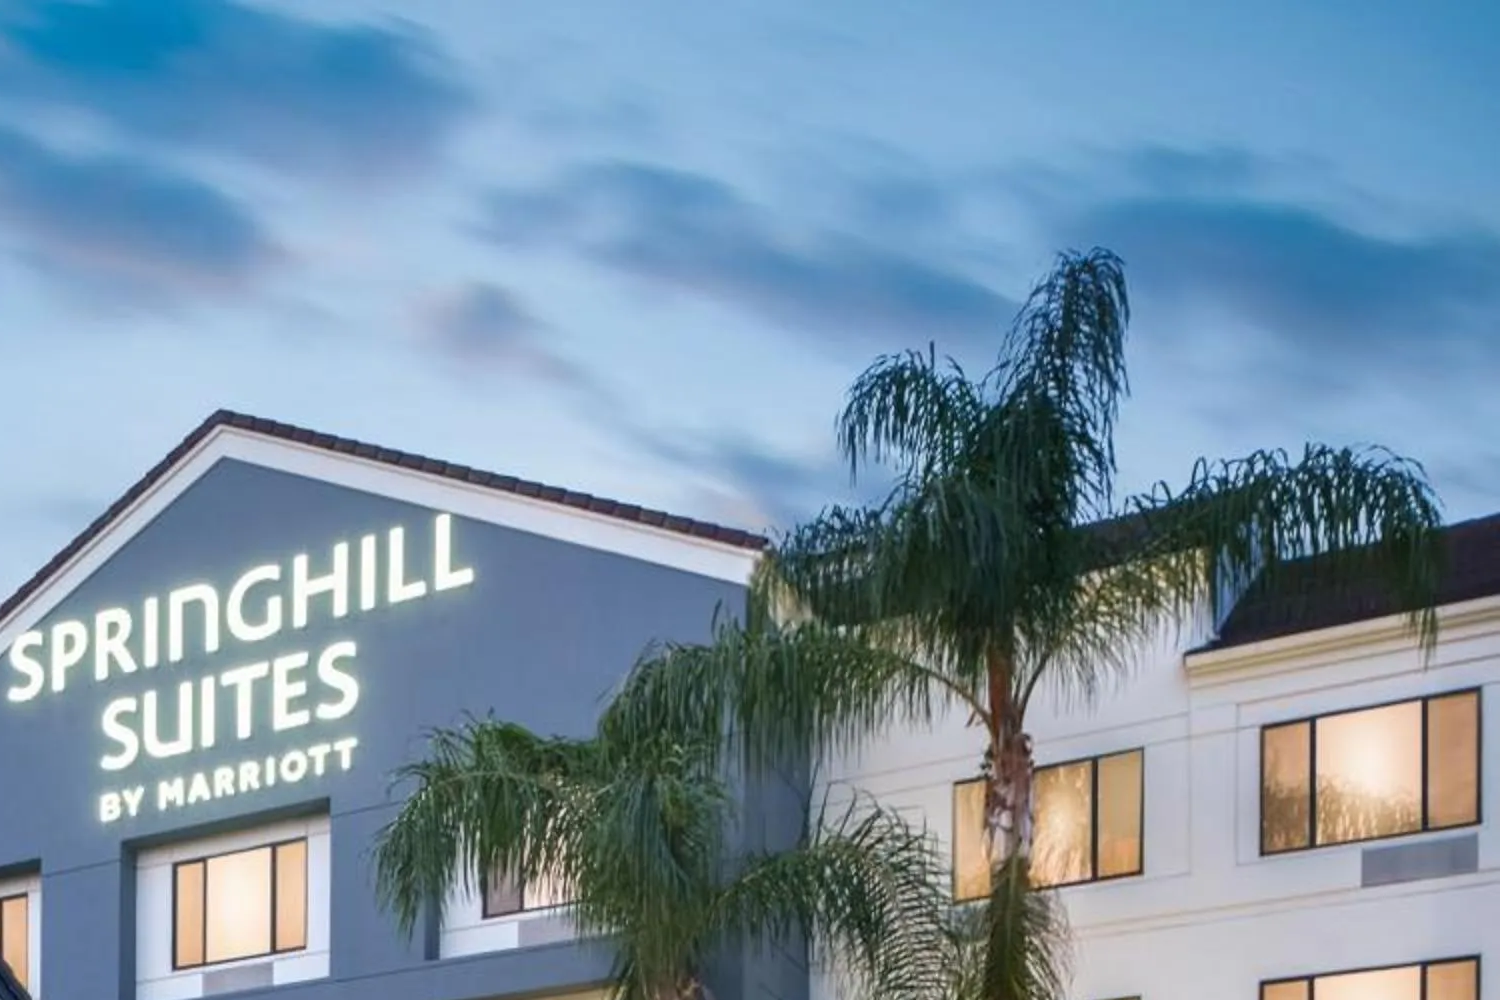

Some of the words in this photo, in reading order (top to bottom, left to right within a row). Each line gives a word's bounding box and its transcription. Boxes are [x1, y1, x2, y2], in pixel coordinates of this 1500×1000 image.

[7, 513, 474, 702] SPRINGHILL
[100, 641, 359, 770] SUITES
[99, 787, 145, 822] BY
[158, 738, 358, 810] MARRIOTT
